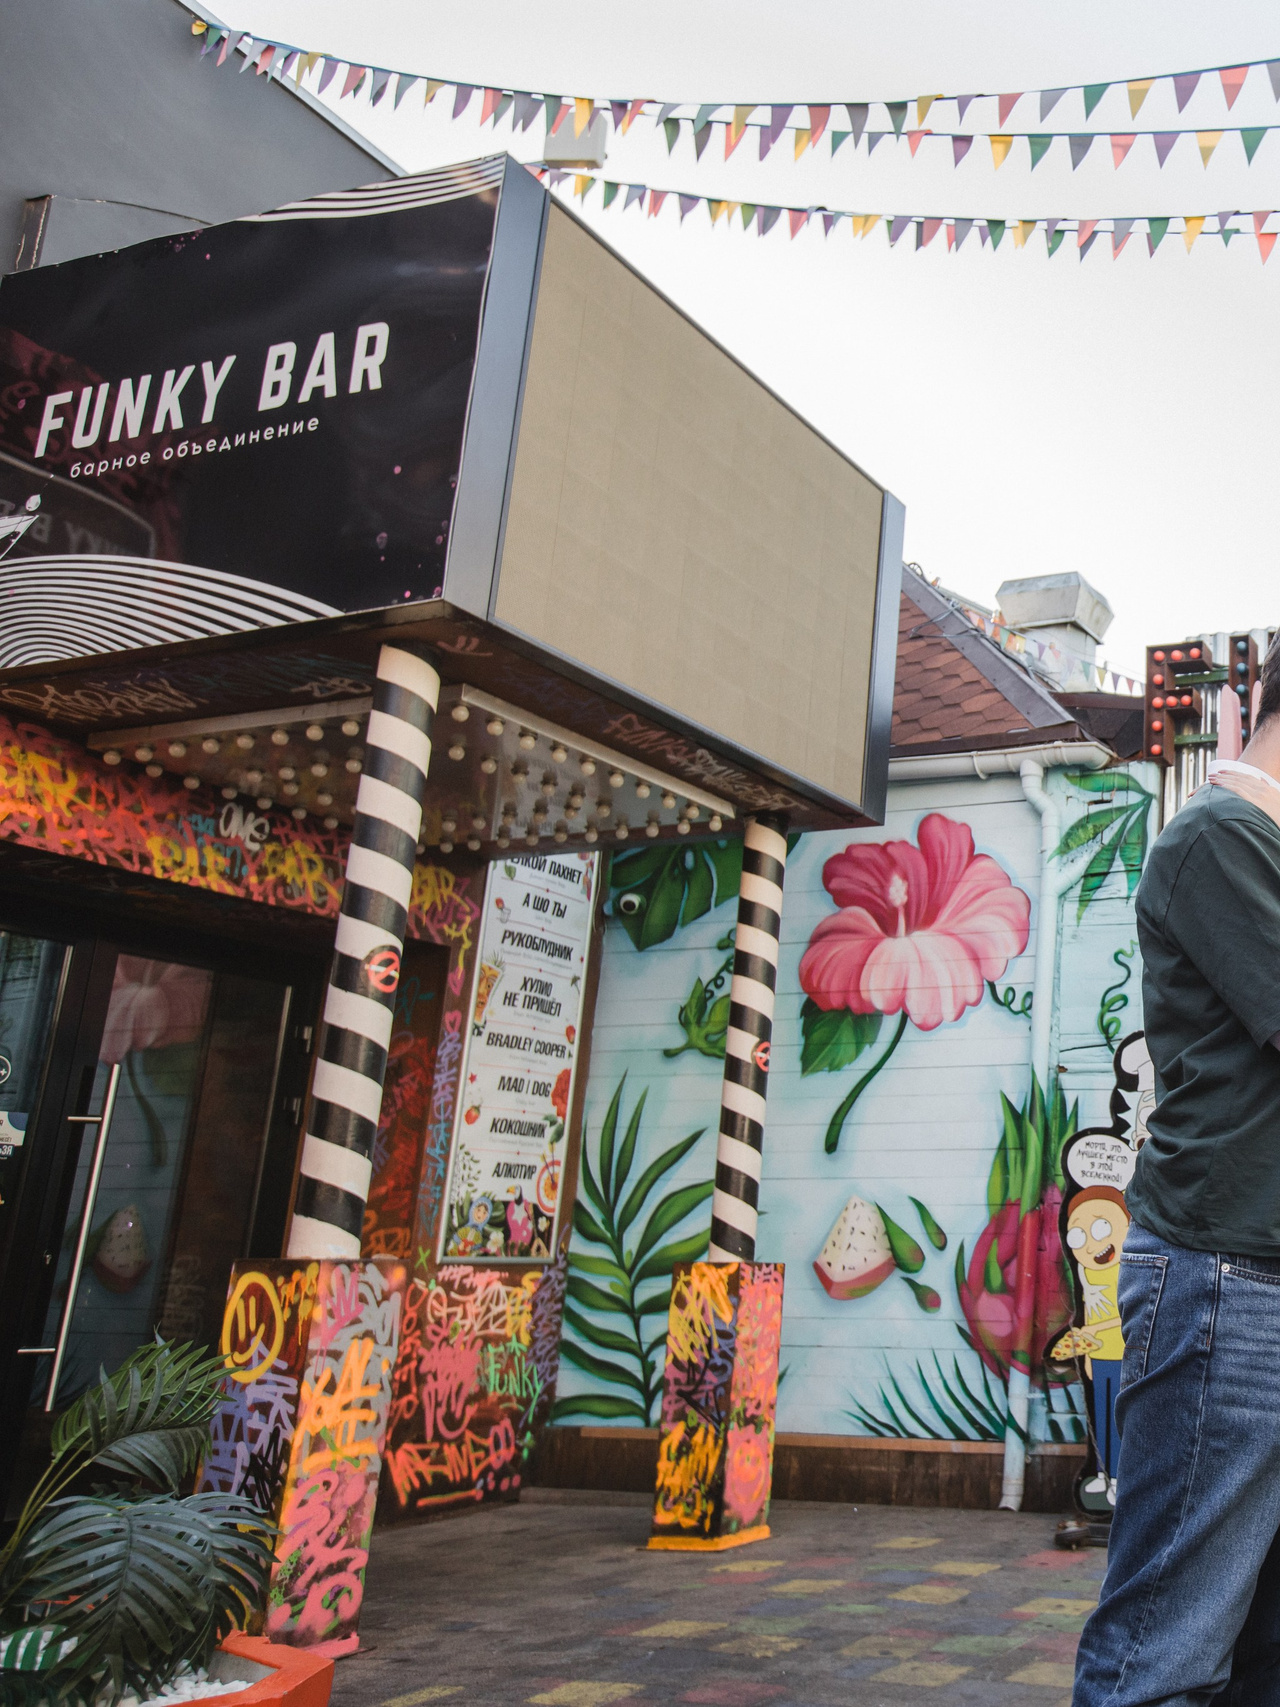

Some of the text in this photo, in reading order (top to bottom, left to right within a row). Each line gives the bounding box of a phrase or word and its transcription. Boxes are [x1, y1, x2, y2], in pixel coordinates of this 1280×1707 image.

[34, 321, 391, 458] FUNKY BAR
[70, 416, 321, 479] барное объединение
[549, 860, 583, 885] ПАХНЕТ
[522, 892, 568, 919] А ШО ТЫ
[501, 930, 574, 962] РУКОБЛУДНИК
[520, 976, 553, 997] ХУЛИО
[502, 991, 520, 1008] НЕ
[522, 994, 562, 1017] ПРИШЁЛ
[486, 1031, 567, 1059] BRADLEY COOPER
[498, 1076, 525, 1093] MAD
[532, 1080, 552, 1097] DOG
[489, 1117, 548, 1139] КОКОШНИК
[1076, 1150, 1128, 1164] ЛУЧШЕЕ МЕСТО
[1110, 1145, 1122, 1153] ЭТО
[491, 1162, 538, 1180] АЛКОТИР
[1098, 1162, 1113, 1171] ЭТОЙ
[488, 1343, 544, 1424] FUNKY
